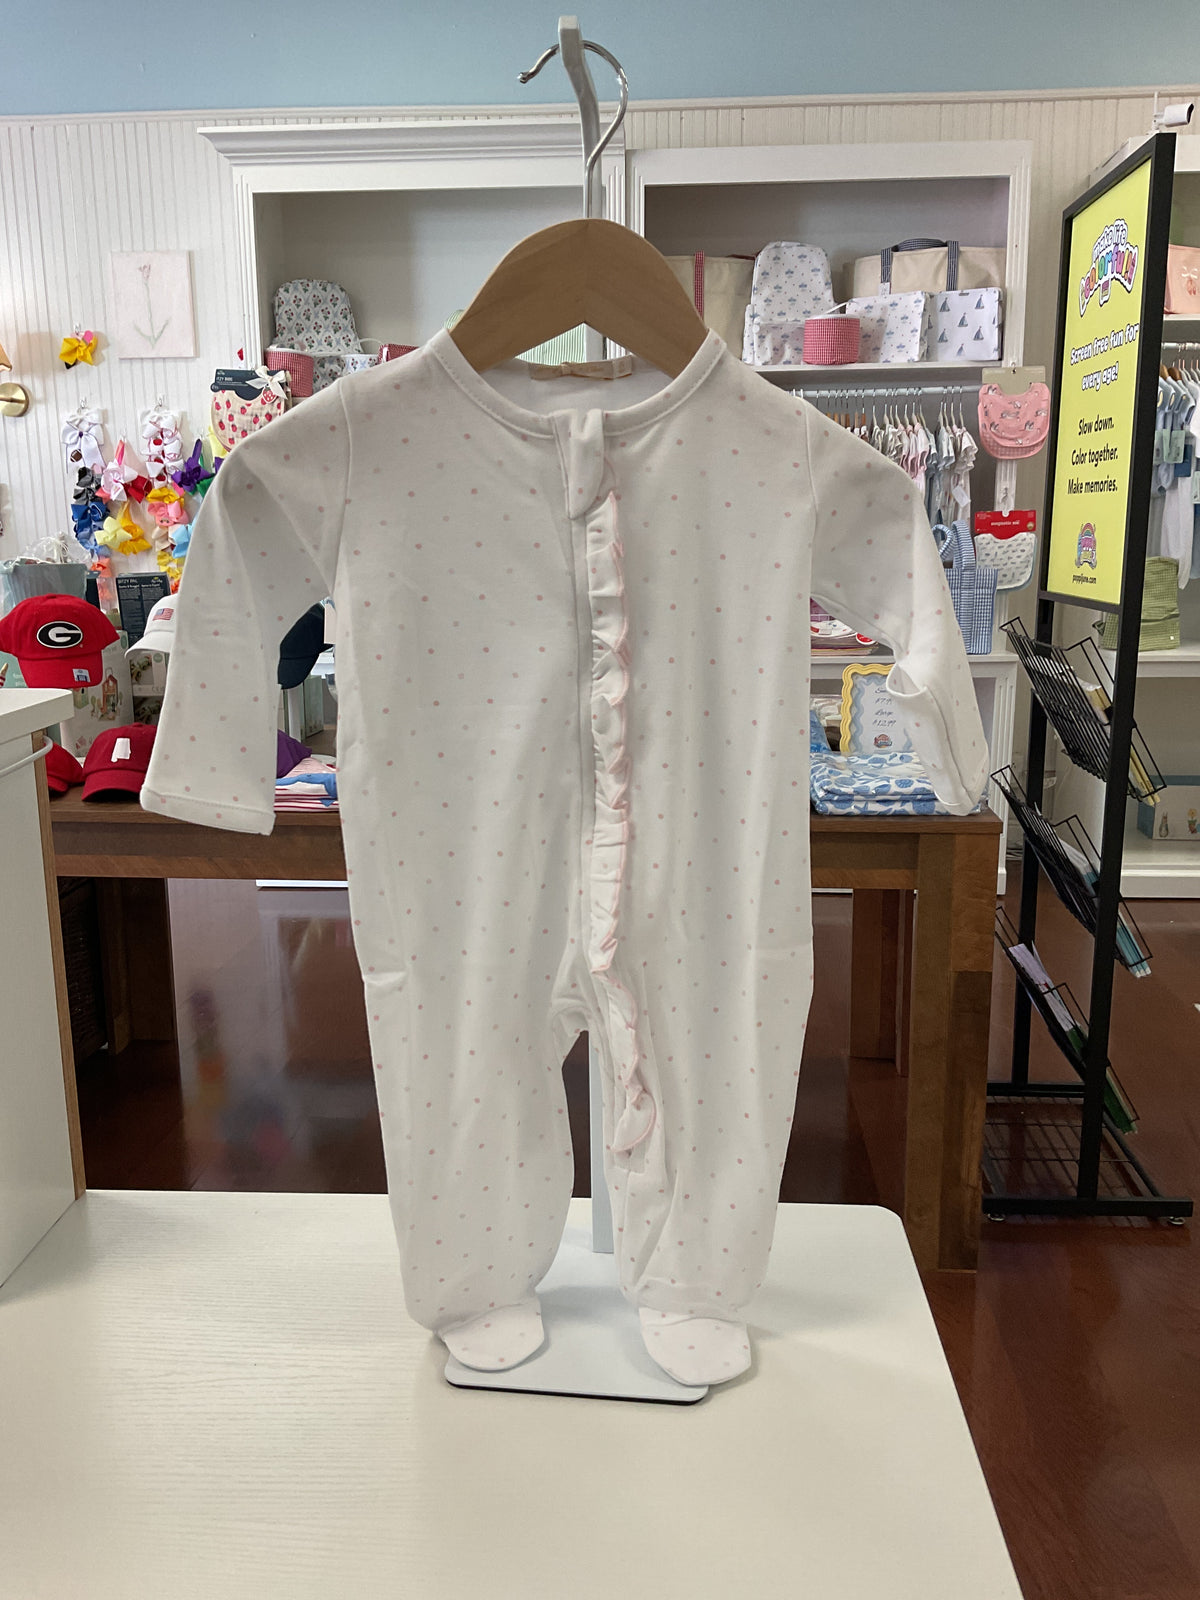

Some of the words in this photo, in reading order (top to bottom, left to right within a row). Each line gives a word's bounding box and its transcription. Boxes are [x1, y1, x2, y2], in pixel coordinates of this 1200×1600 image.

[1071, 343, 1092, 366] Screen
[1093, 337, 1109, 356] free
[1110, 330, 1123, 350] fun
[1125, 323, 1139, 344] for
[1082, 370, 1101, 392] every
[1102, 361, 1119, 385] age!
[1078, 418, 1093, 436] Slow
[1094, 414, 1114, 432] down.
[1071, 448, 1087, 466] Color
[1088, 443, 1118, 467] together.
[1068, 477, 1083, 494] Make
[1084, 474, 1118, 493] memories.
